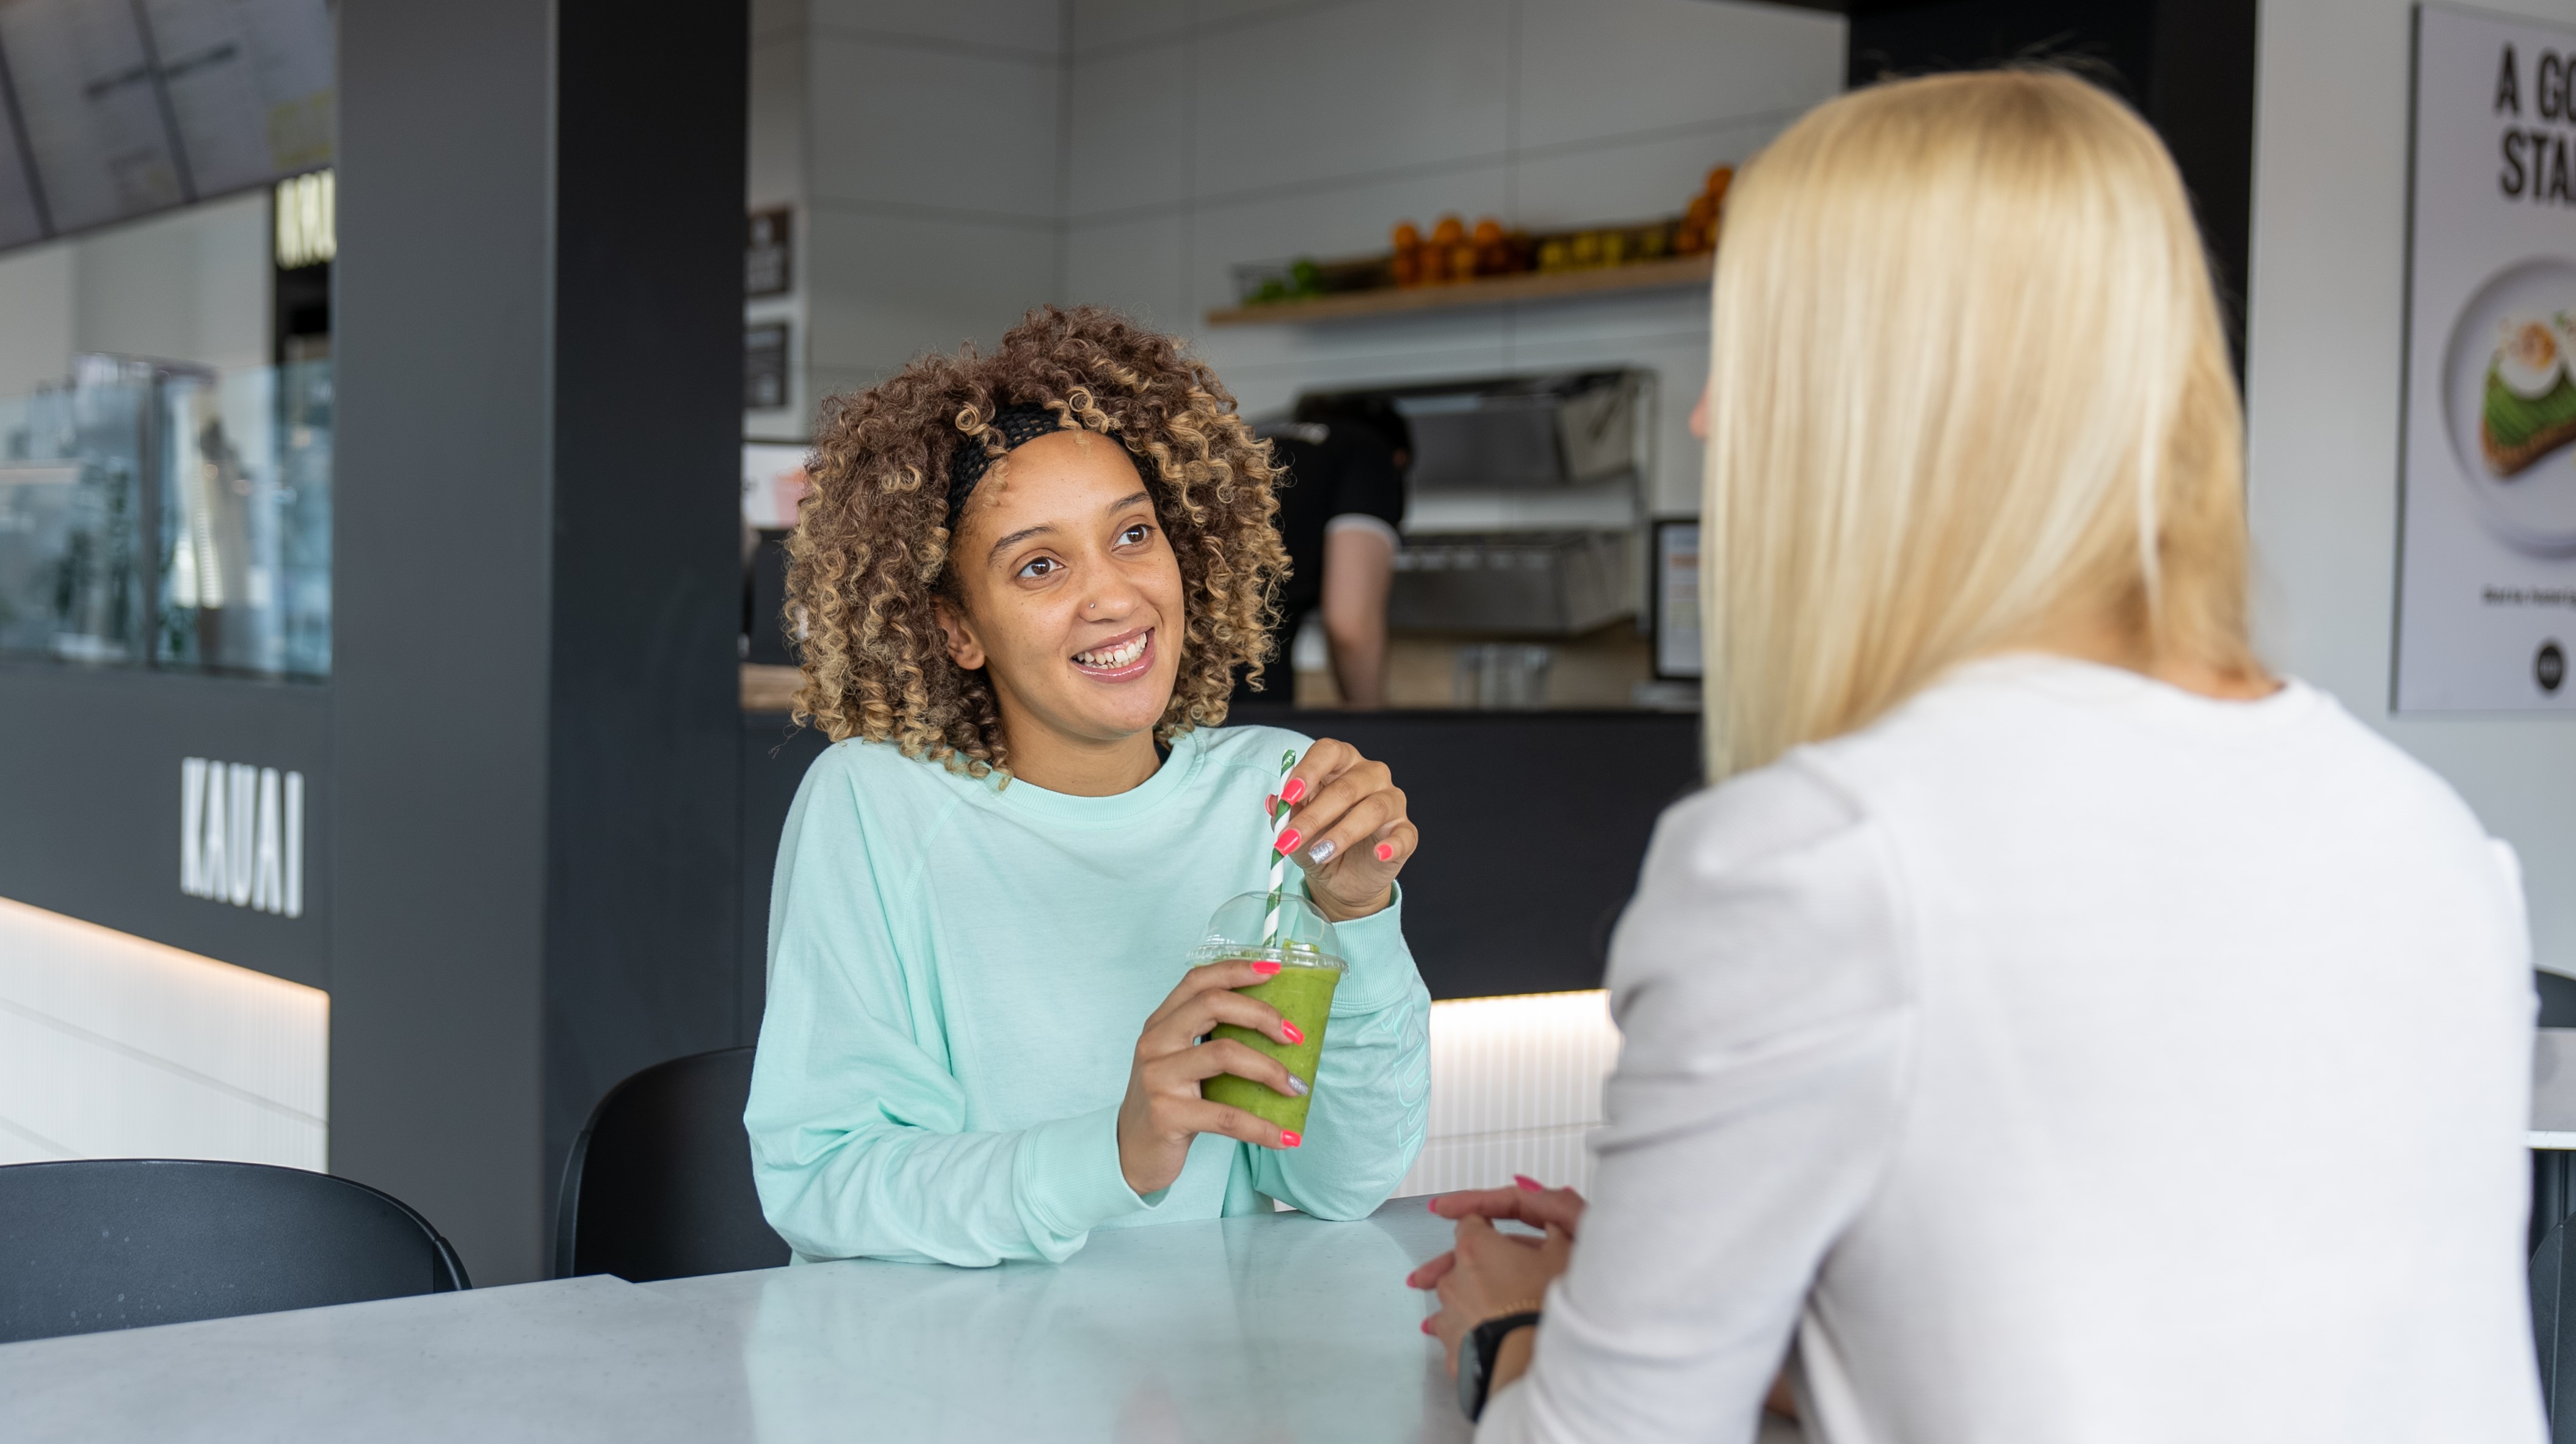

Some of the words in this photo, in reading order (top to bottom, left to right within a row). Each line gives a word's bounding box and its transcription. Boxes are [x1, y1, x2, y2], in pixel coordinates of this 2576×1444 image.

[2494, 42, 2520, 115] A
[2502, 129, 2576, 205] STA
[181, 756, 304, 918] KAUAI
